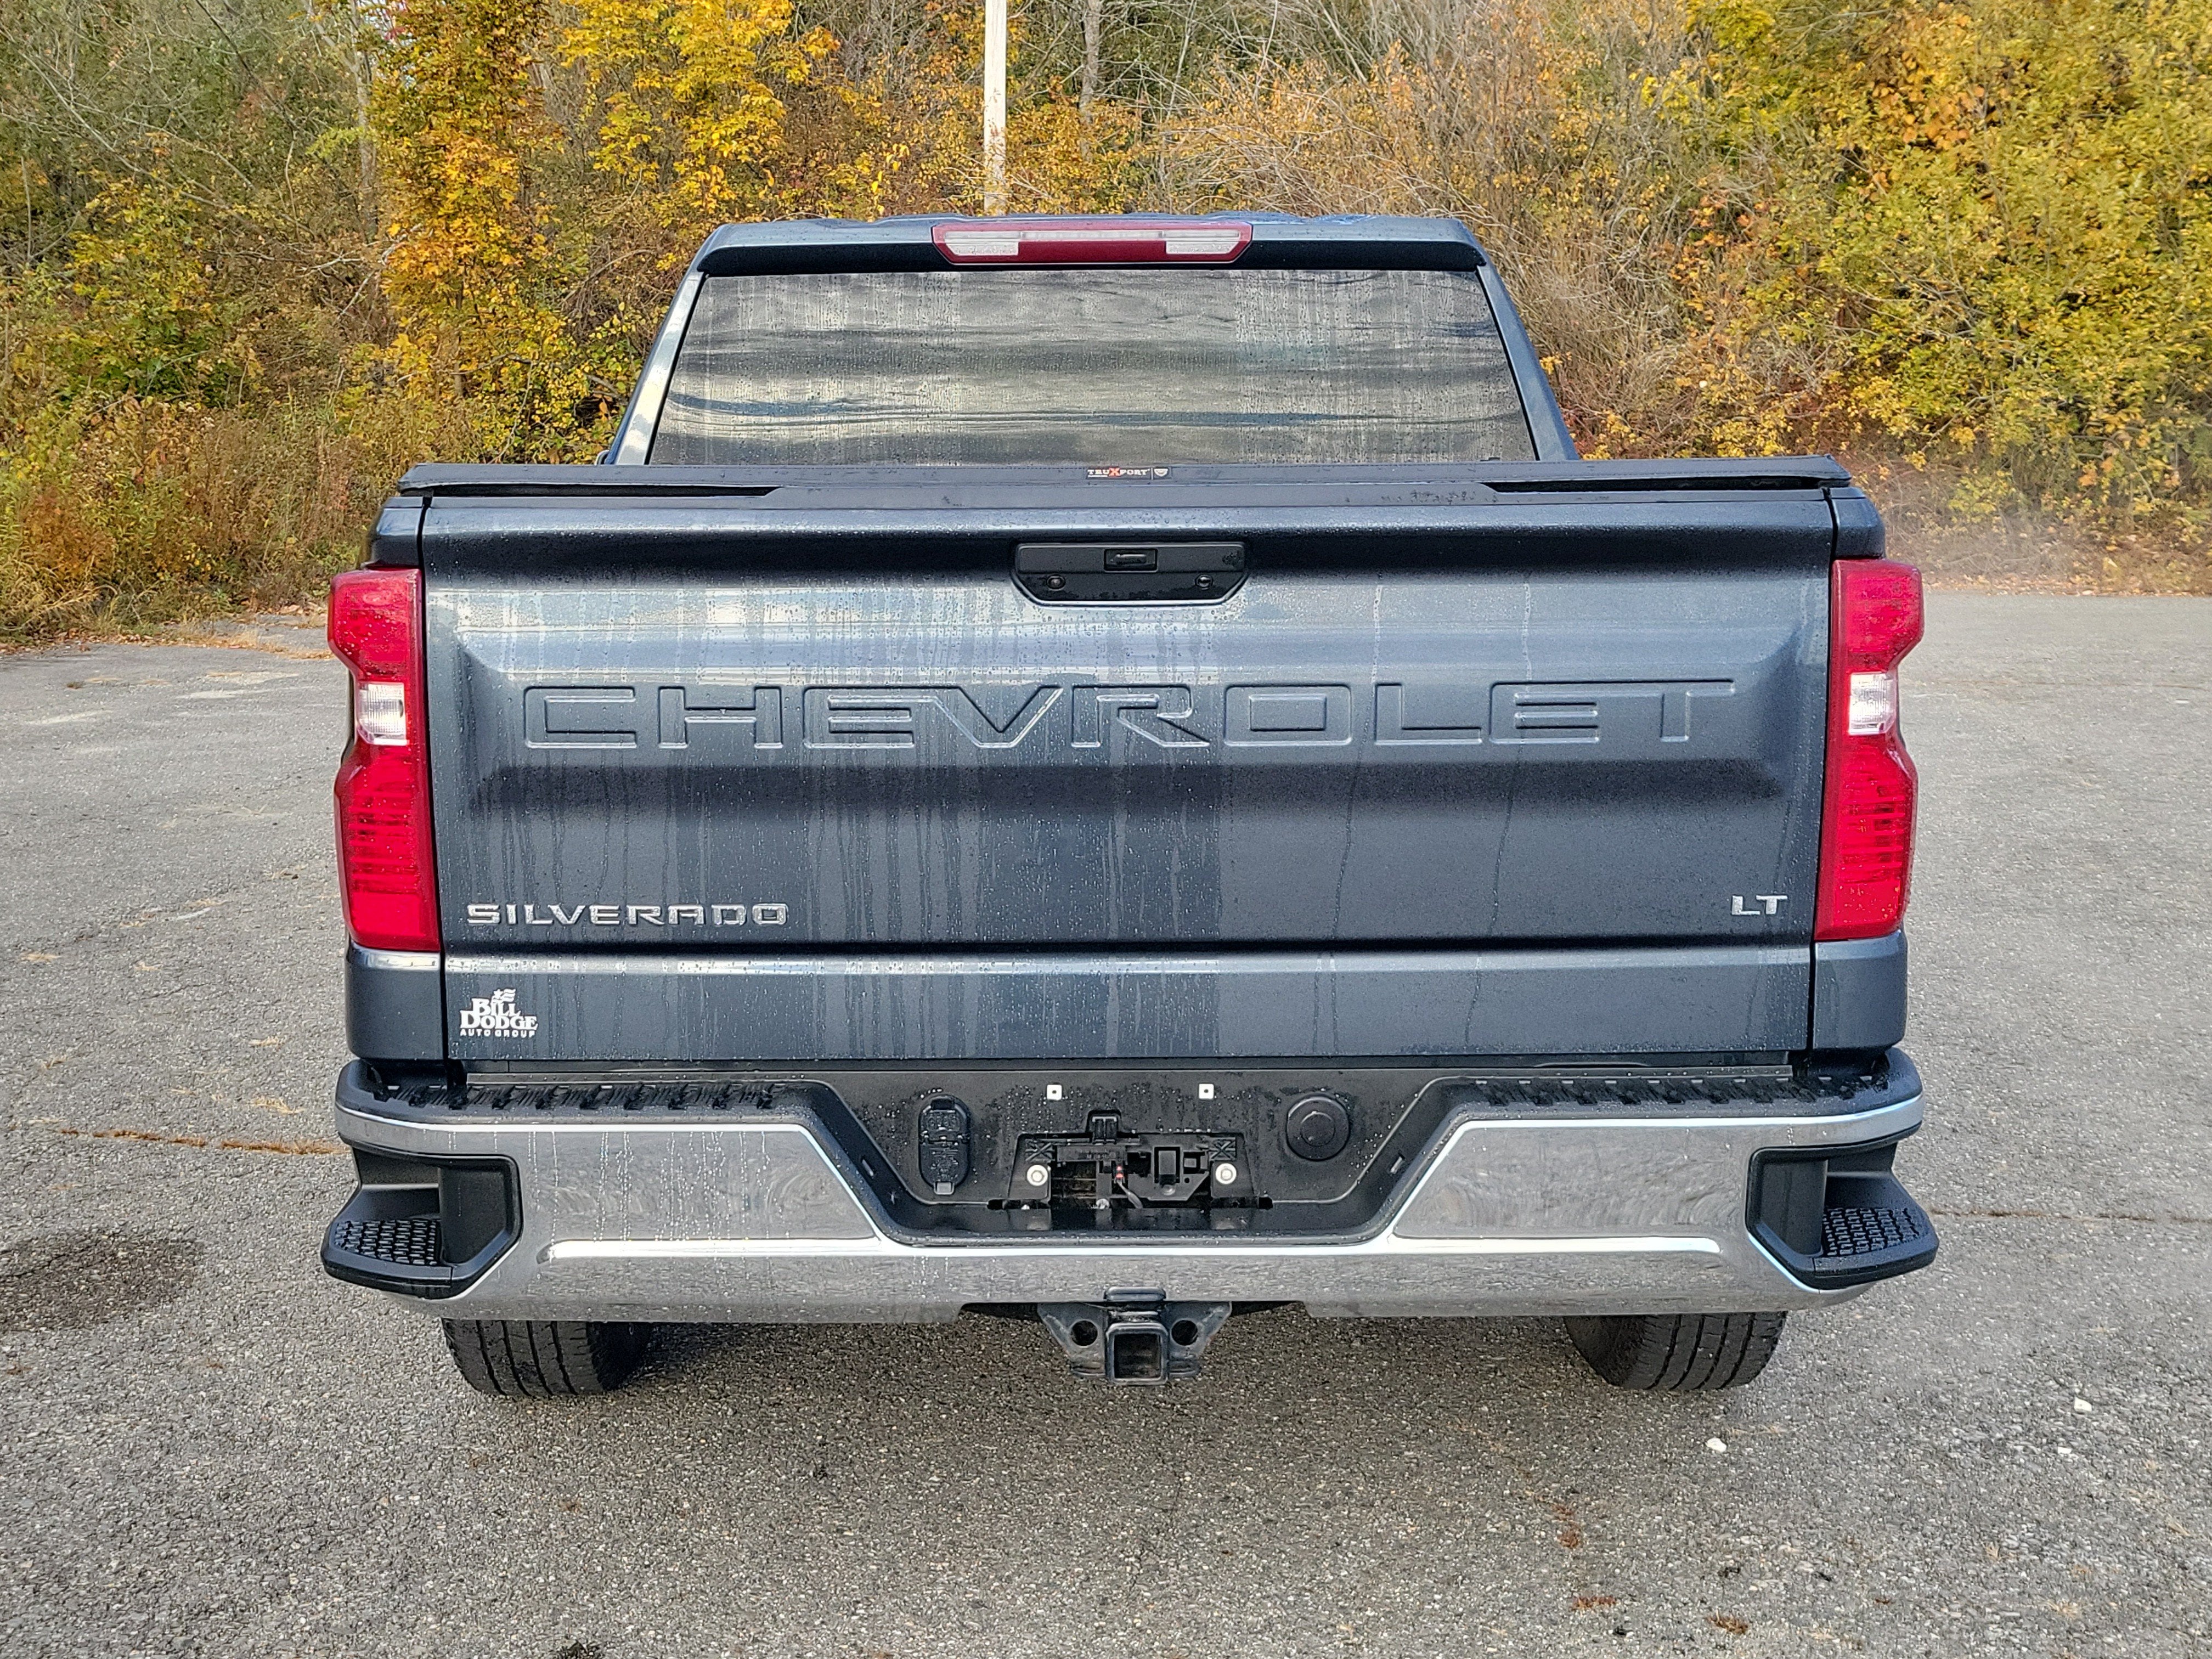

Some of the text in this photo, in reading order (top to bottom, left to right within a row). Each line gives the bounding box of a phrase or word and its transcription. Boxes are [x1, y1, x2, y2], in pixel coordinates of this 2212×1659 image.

[1087, 467, 1150, 477] TRUXPORT
[524, 678, 1735, 749] CHEVROLET
[466, 902, 789, 926] SILVERADO
[1731, 895, 1788, 915] LT
[471, 997, 521, 1017] BILL
[460, 1010, 539, 1030] DODGE
[459, 1028, 535, 1038] AUTO GROUP
